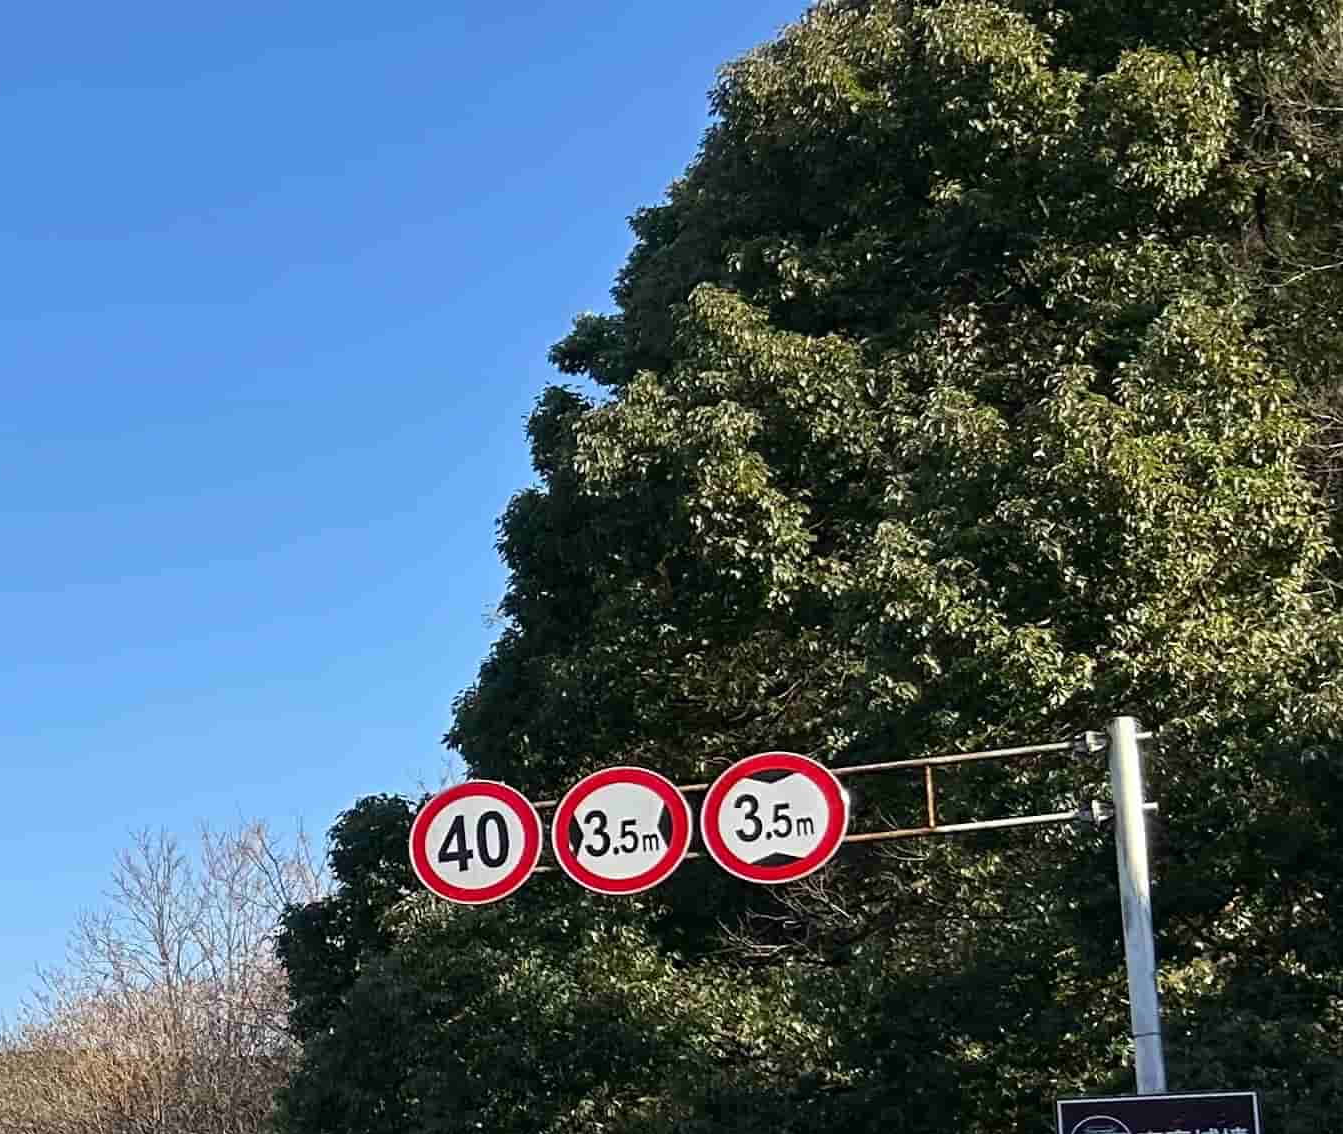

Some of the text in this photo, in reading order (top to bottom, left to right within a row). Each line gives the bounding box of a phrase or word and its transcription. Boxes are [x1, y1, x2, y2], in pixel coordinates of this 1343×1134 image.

[437, 810, 511, 873] 40
[583, 810, 660, 858] 3.5m
[734, 793, 815, 842] 3.5m
